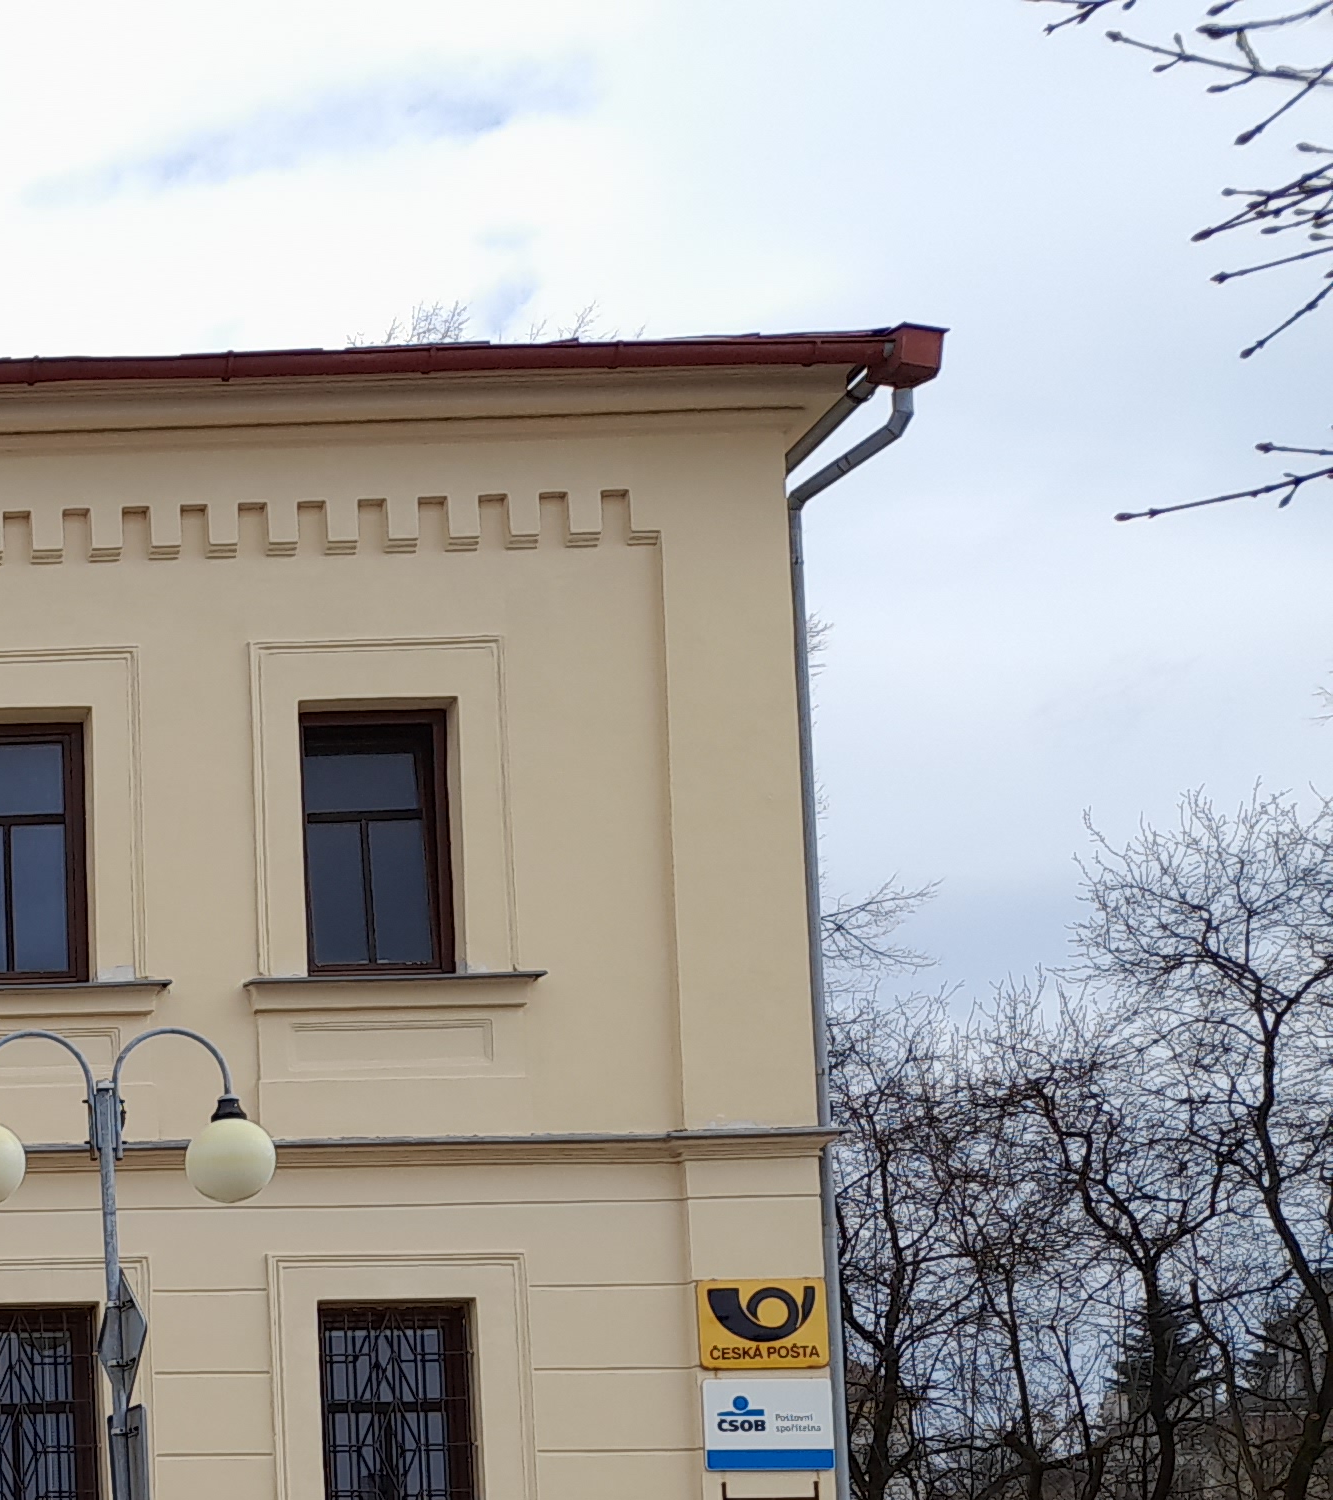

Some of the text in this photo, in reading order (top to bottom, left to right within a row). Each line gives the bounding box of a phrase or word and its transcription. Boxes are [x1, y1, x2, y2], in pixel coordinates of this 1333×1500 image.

[709, 1343, 820, 1360] ČESKÁ POŠTA
[775, 1413, 813, 1422] Poštovní
[717, 1418, 766, 1432] ČSOB
[775, 1424, 821, 1433] spořitelna
